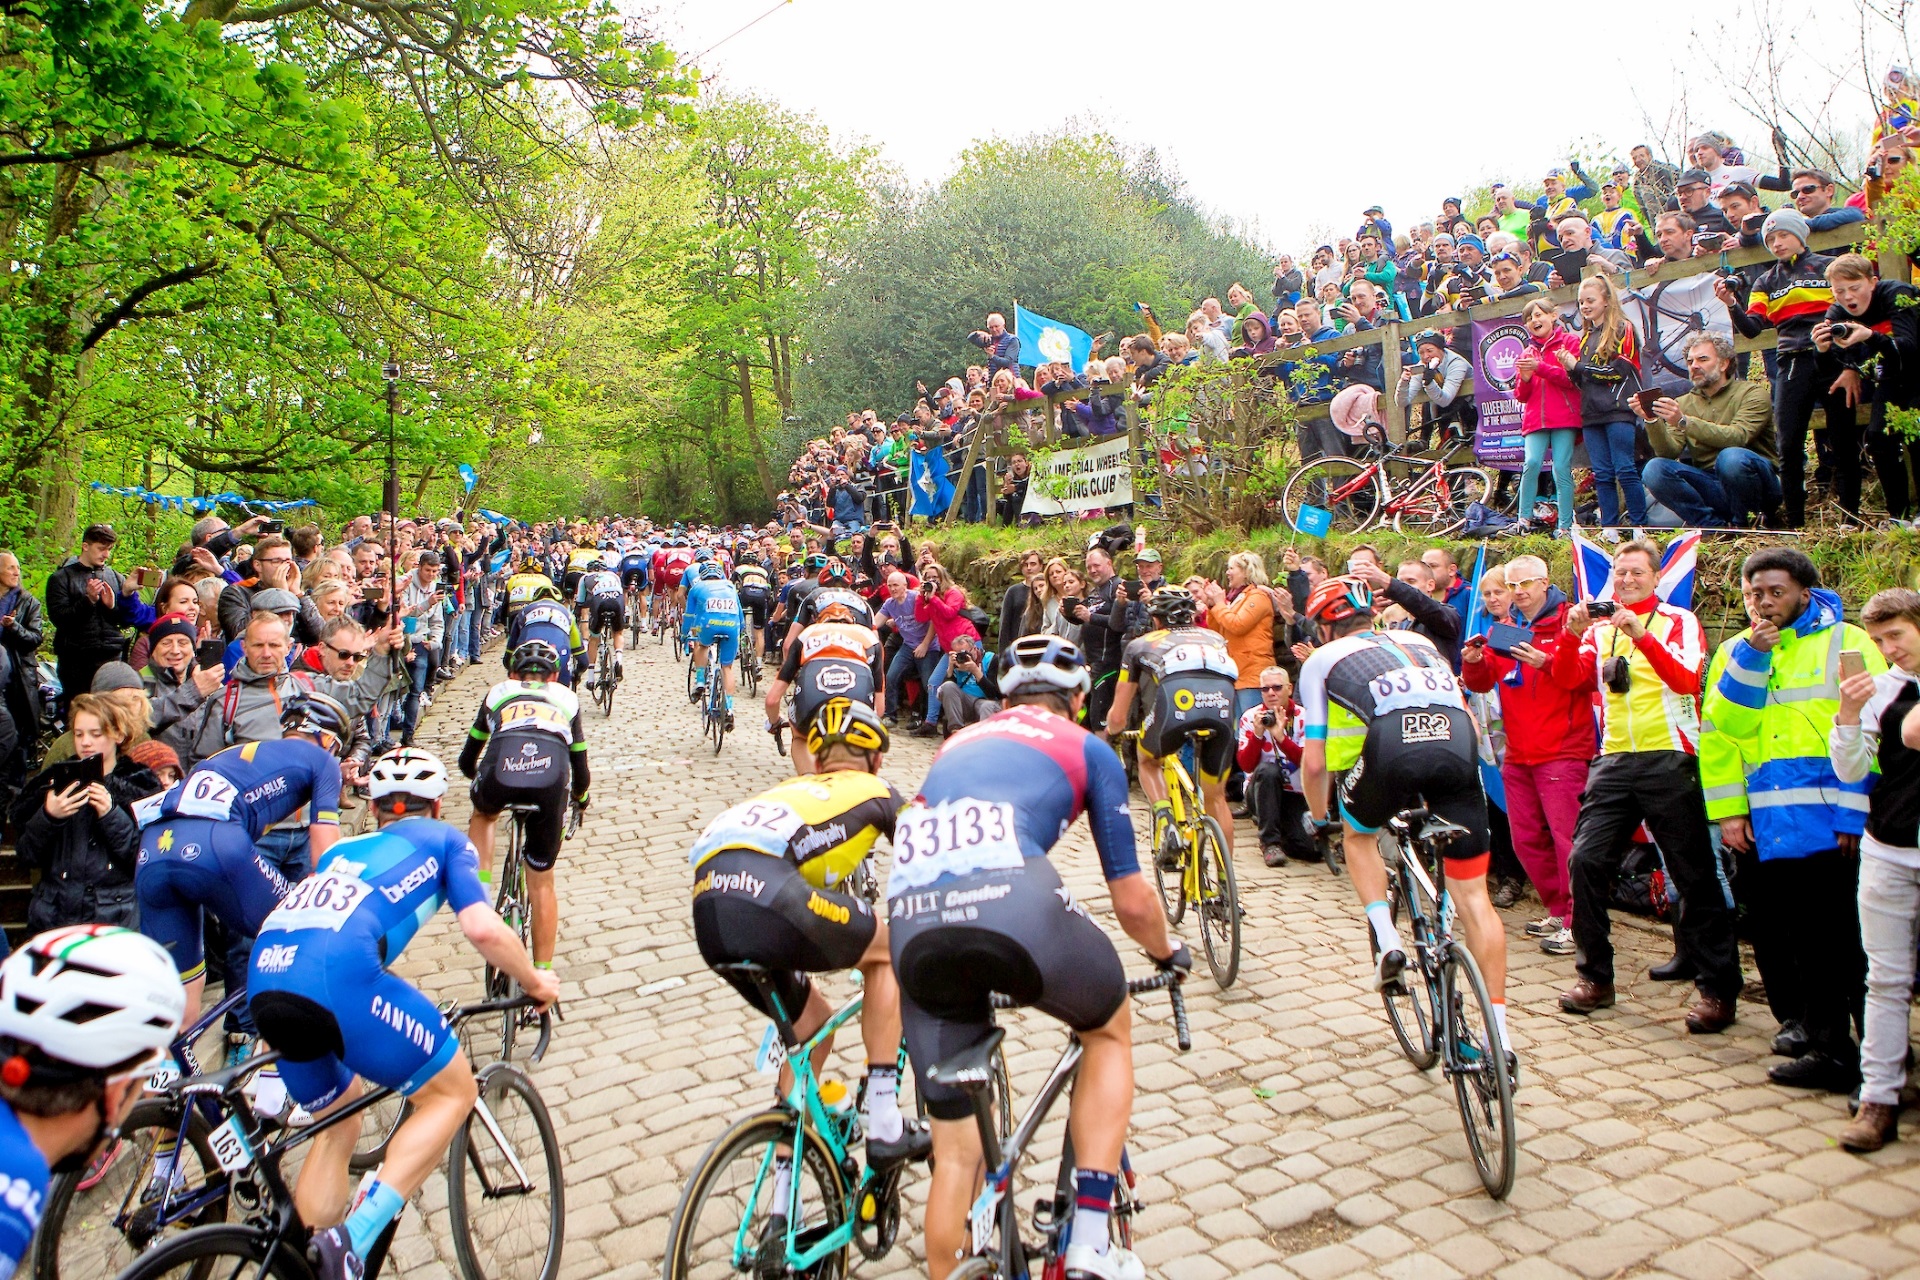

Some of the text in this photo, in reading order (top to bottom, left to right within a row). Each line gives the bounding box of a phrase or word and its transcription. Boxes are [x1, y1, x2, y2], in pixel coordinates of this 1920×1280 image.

[1487, 326, 1527, 343] QUEENSBURY
[1055, 459, 1094, 476] IMPRIAL
[1090, 474, 1117, 496] CLUB
[1177, 648, 1187, 661] 6
[1376, 670, 1454, 697] 83 83
[1194, 690, 1223, 700] direct
[509, 704, 536, 721] 75
[502, 755, 552, 772] Nederburg
[194, 776, 231, 803] 62
[741, 804, 789, 831] 52
[807, 890, 850, 925] JUMBO
[904, 884, 1011, 920] JLT Condor
[256, 945, 299, 968] BIKE
[371, 994, 435, 1056] CANYON
[151, 1071, 169, 1089] 62
[212, 1129, 242, 1166] 163
